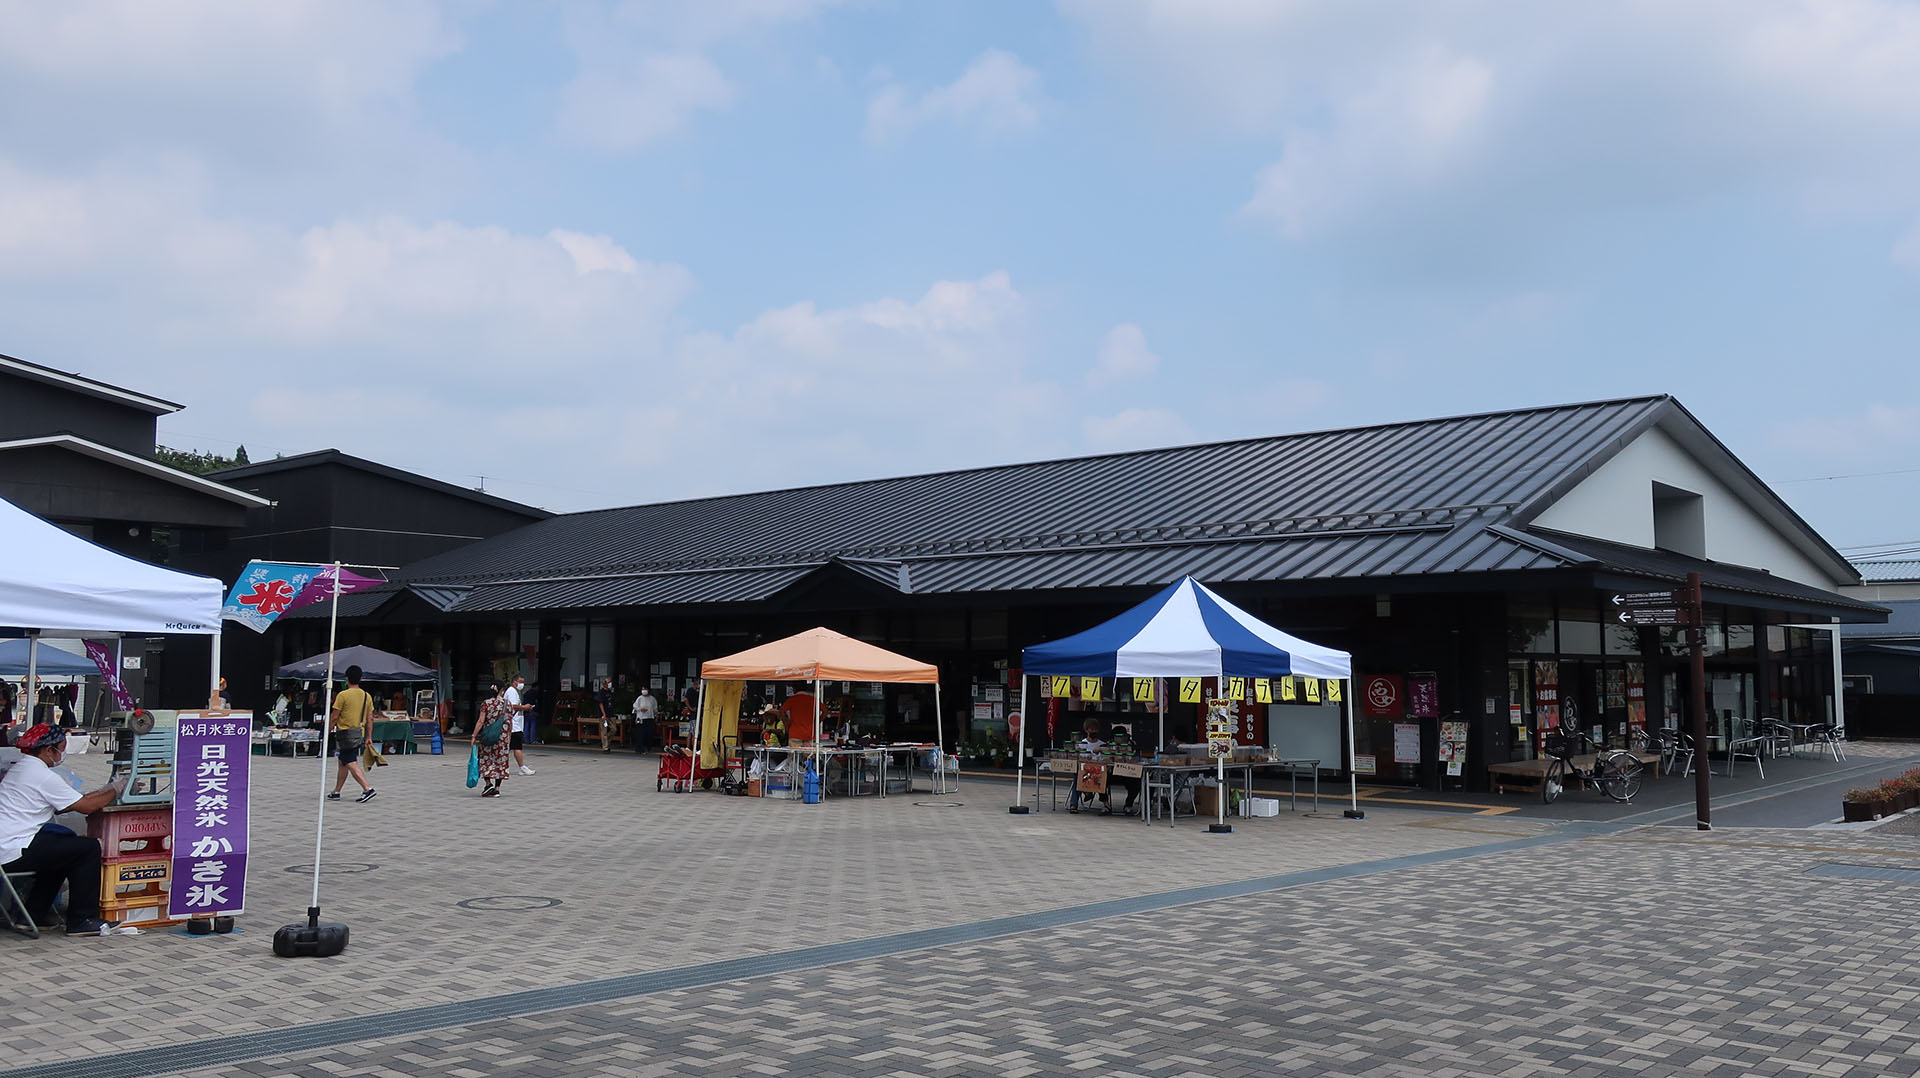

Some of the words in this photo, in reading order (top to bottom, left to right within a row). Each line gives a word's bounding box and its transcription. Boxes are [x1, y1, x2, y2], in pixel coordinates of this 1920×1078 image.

[180, 723, 247, 737] 松月氷室の
[194, 744, 230, 828] 日光天然氷
[125, 822, 167, 833] SAPPORO
[121, 869, 165, 879] キリンレモン
[185, 835, 233, 907] かき氷
